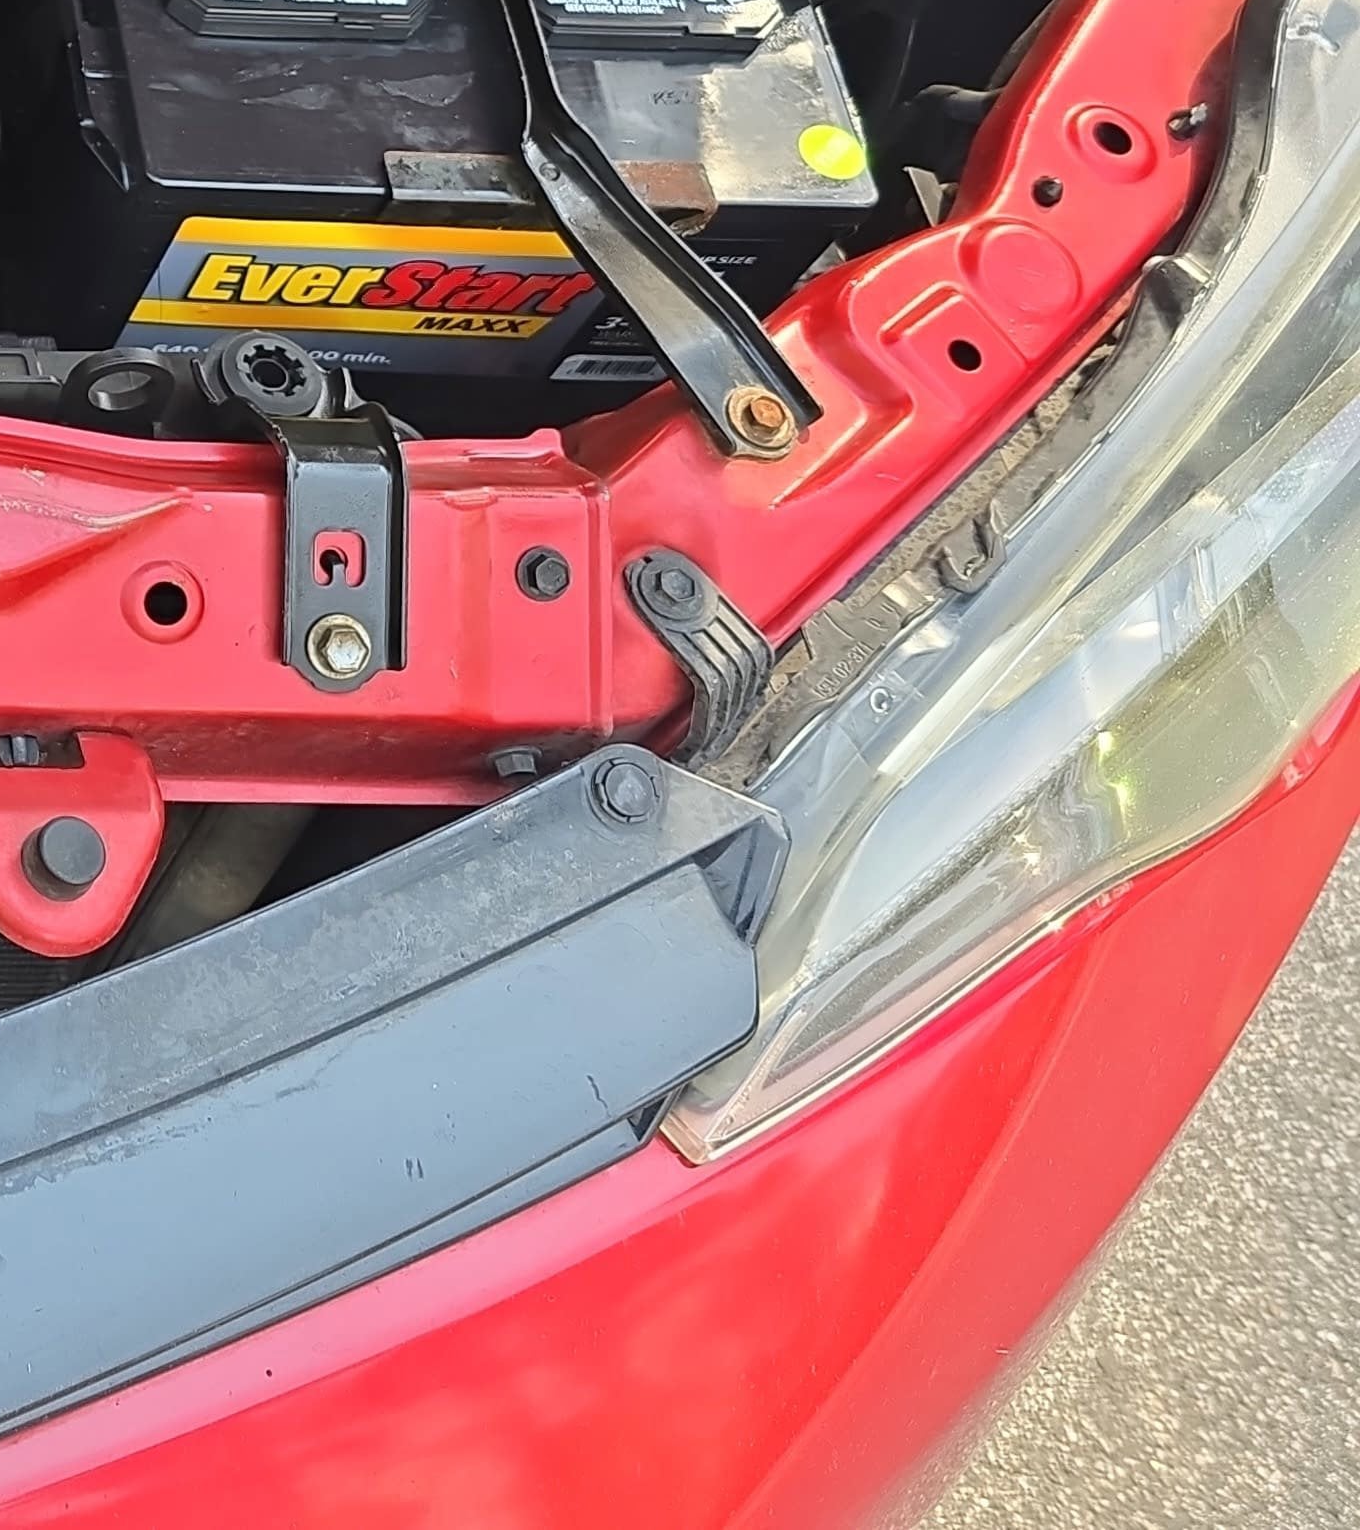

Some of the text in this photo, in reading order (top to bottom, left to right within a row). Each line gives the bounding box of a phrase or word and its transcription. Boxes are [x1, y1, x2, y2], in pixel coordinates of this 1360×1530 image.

[716, 256, 758, 265] SIZE
[184, 252, 597, 314] EverStart
[413, 316, 533, 334] MAXX
[305, 349, 340, 360] 00
